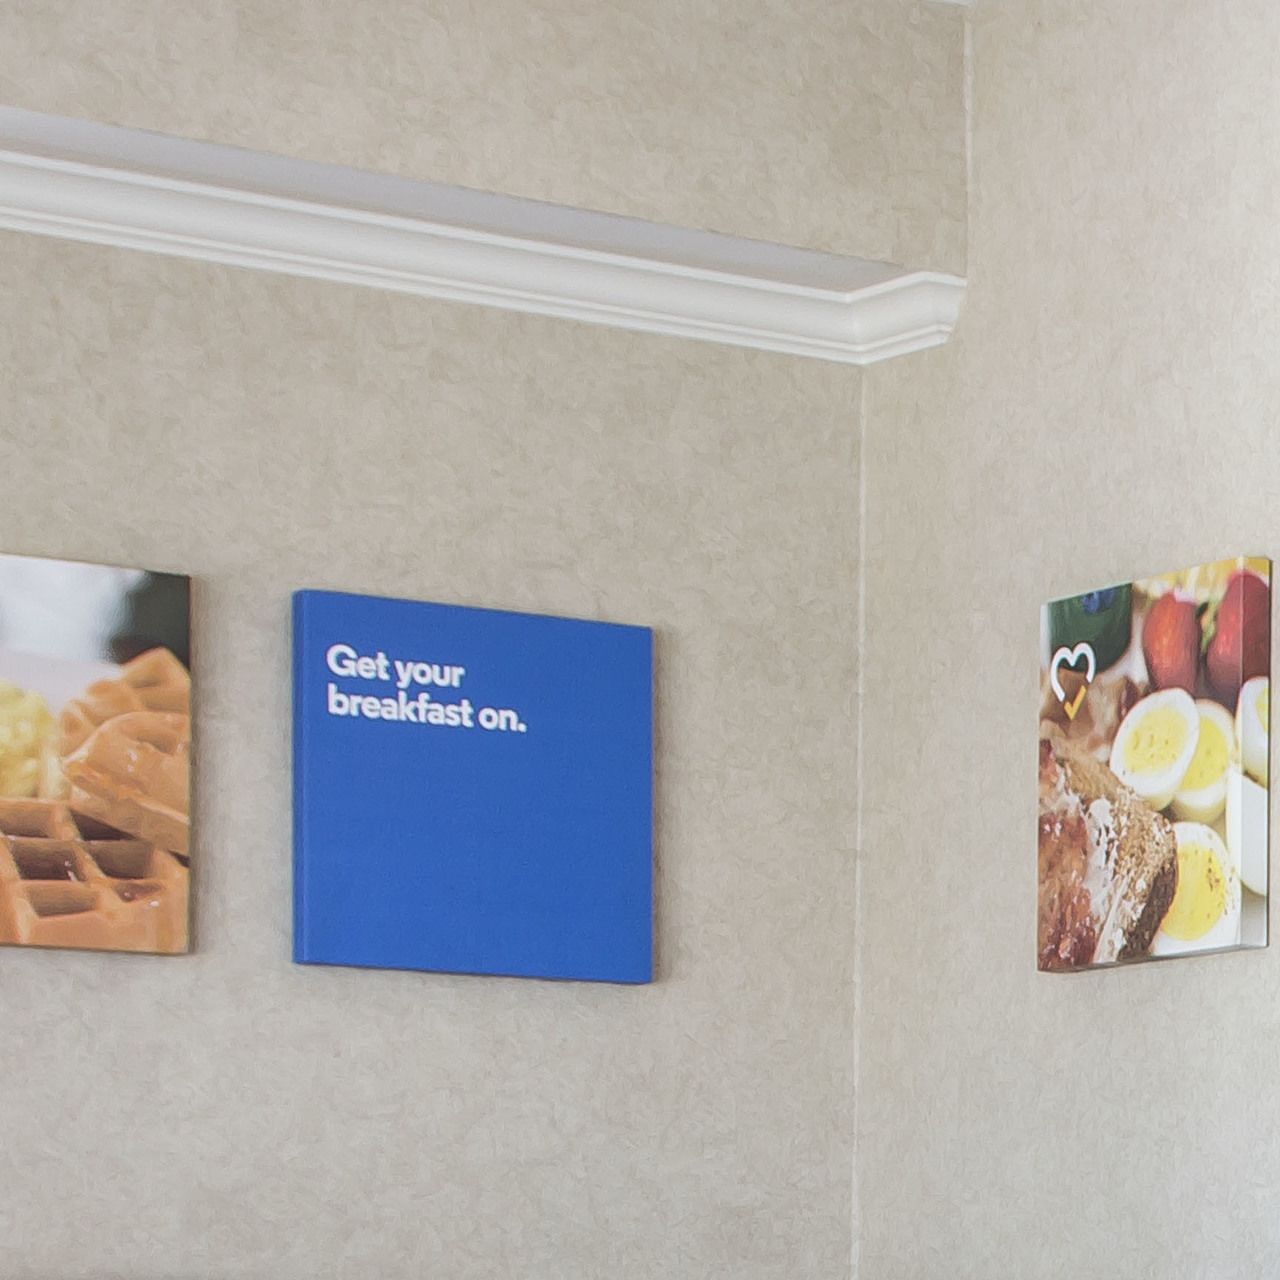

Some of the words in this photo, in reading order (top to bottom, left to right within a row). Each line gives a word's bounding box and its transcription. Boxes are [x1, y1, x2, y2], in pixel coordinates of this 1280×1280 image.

[326, 643, 391, 681] Get
[394, 659, 466, 689] your
[327, 682, 475, 729] breakfast
[477, 706, 528, 733] on.
